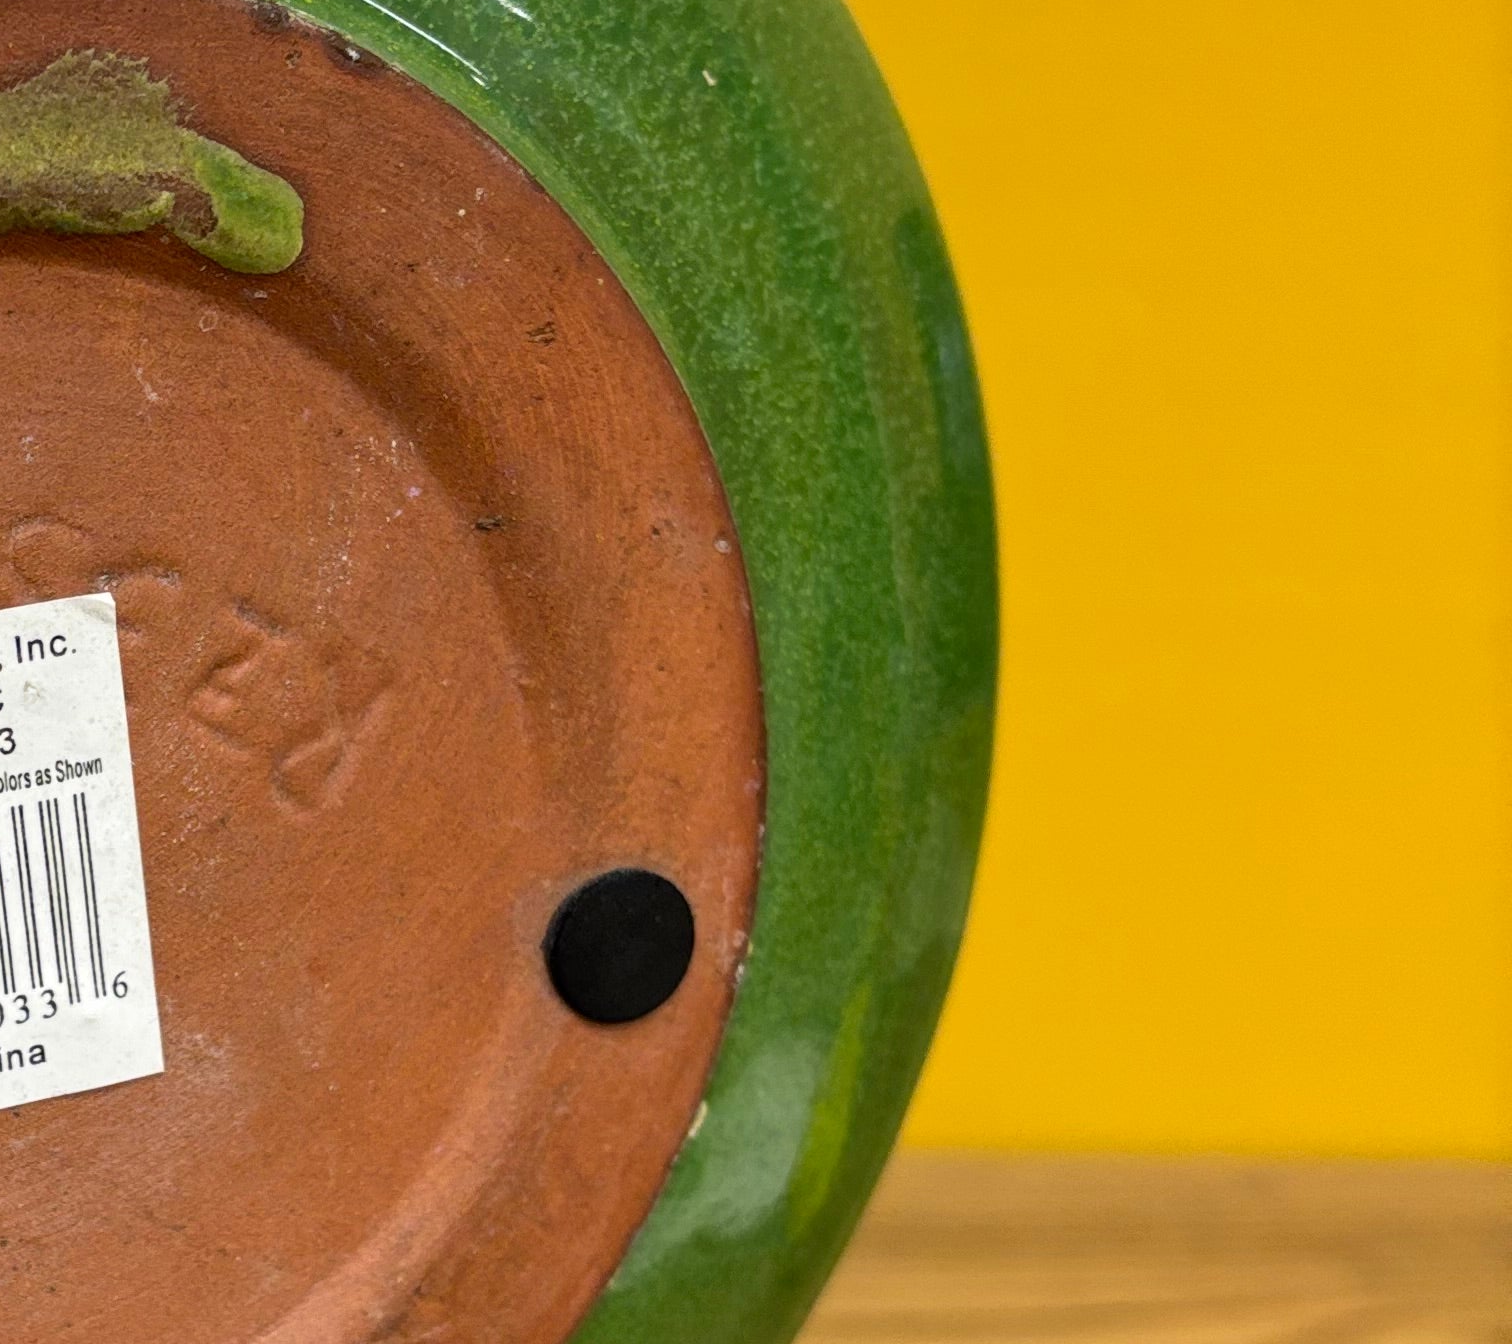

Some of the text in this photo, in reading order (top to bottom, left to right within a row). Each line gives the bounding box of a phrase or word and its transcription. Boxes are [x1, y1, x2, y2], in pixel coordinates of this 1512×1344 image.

[14, 634, 78, 664] Inc.
[36, 768, 52, 786] as
[55, 757, 103, 783] Shown
[111, 970, 129, 999] 6
